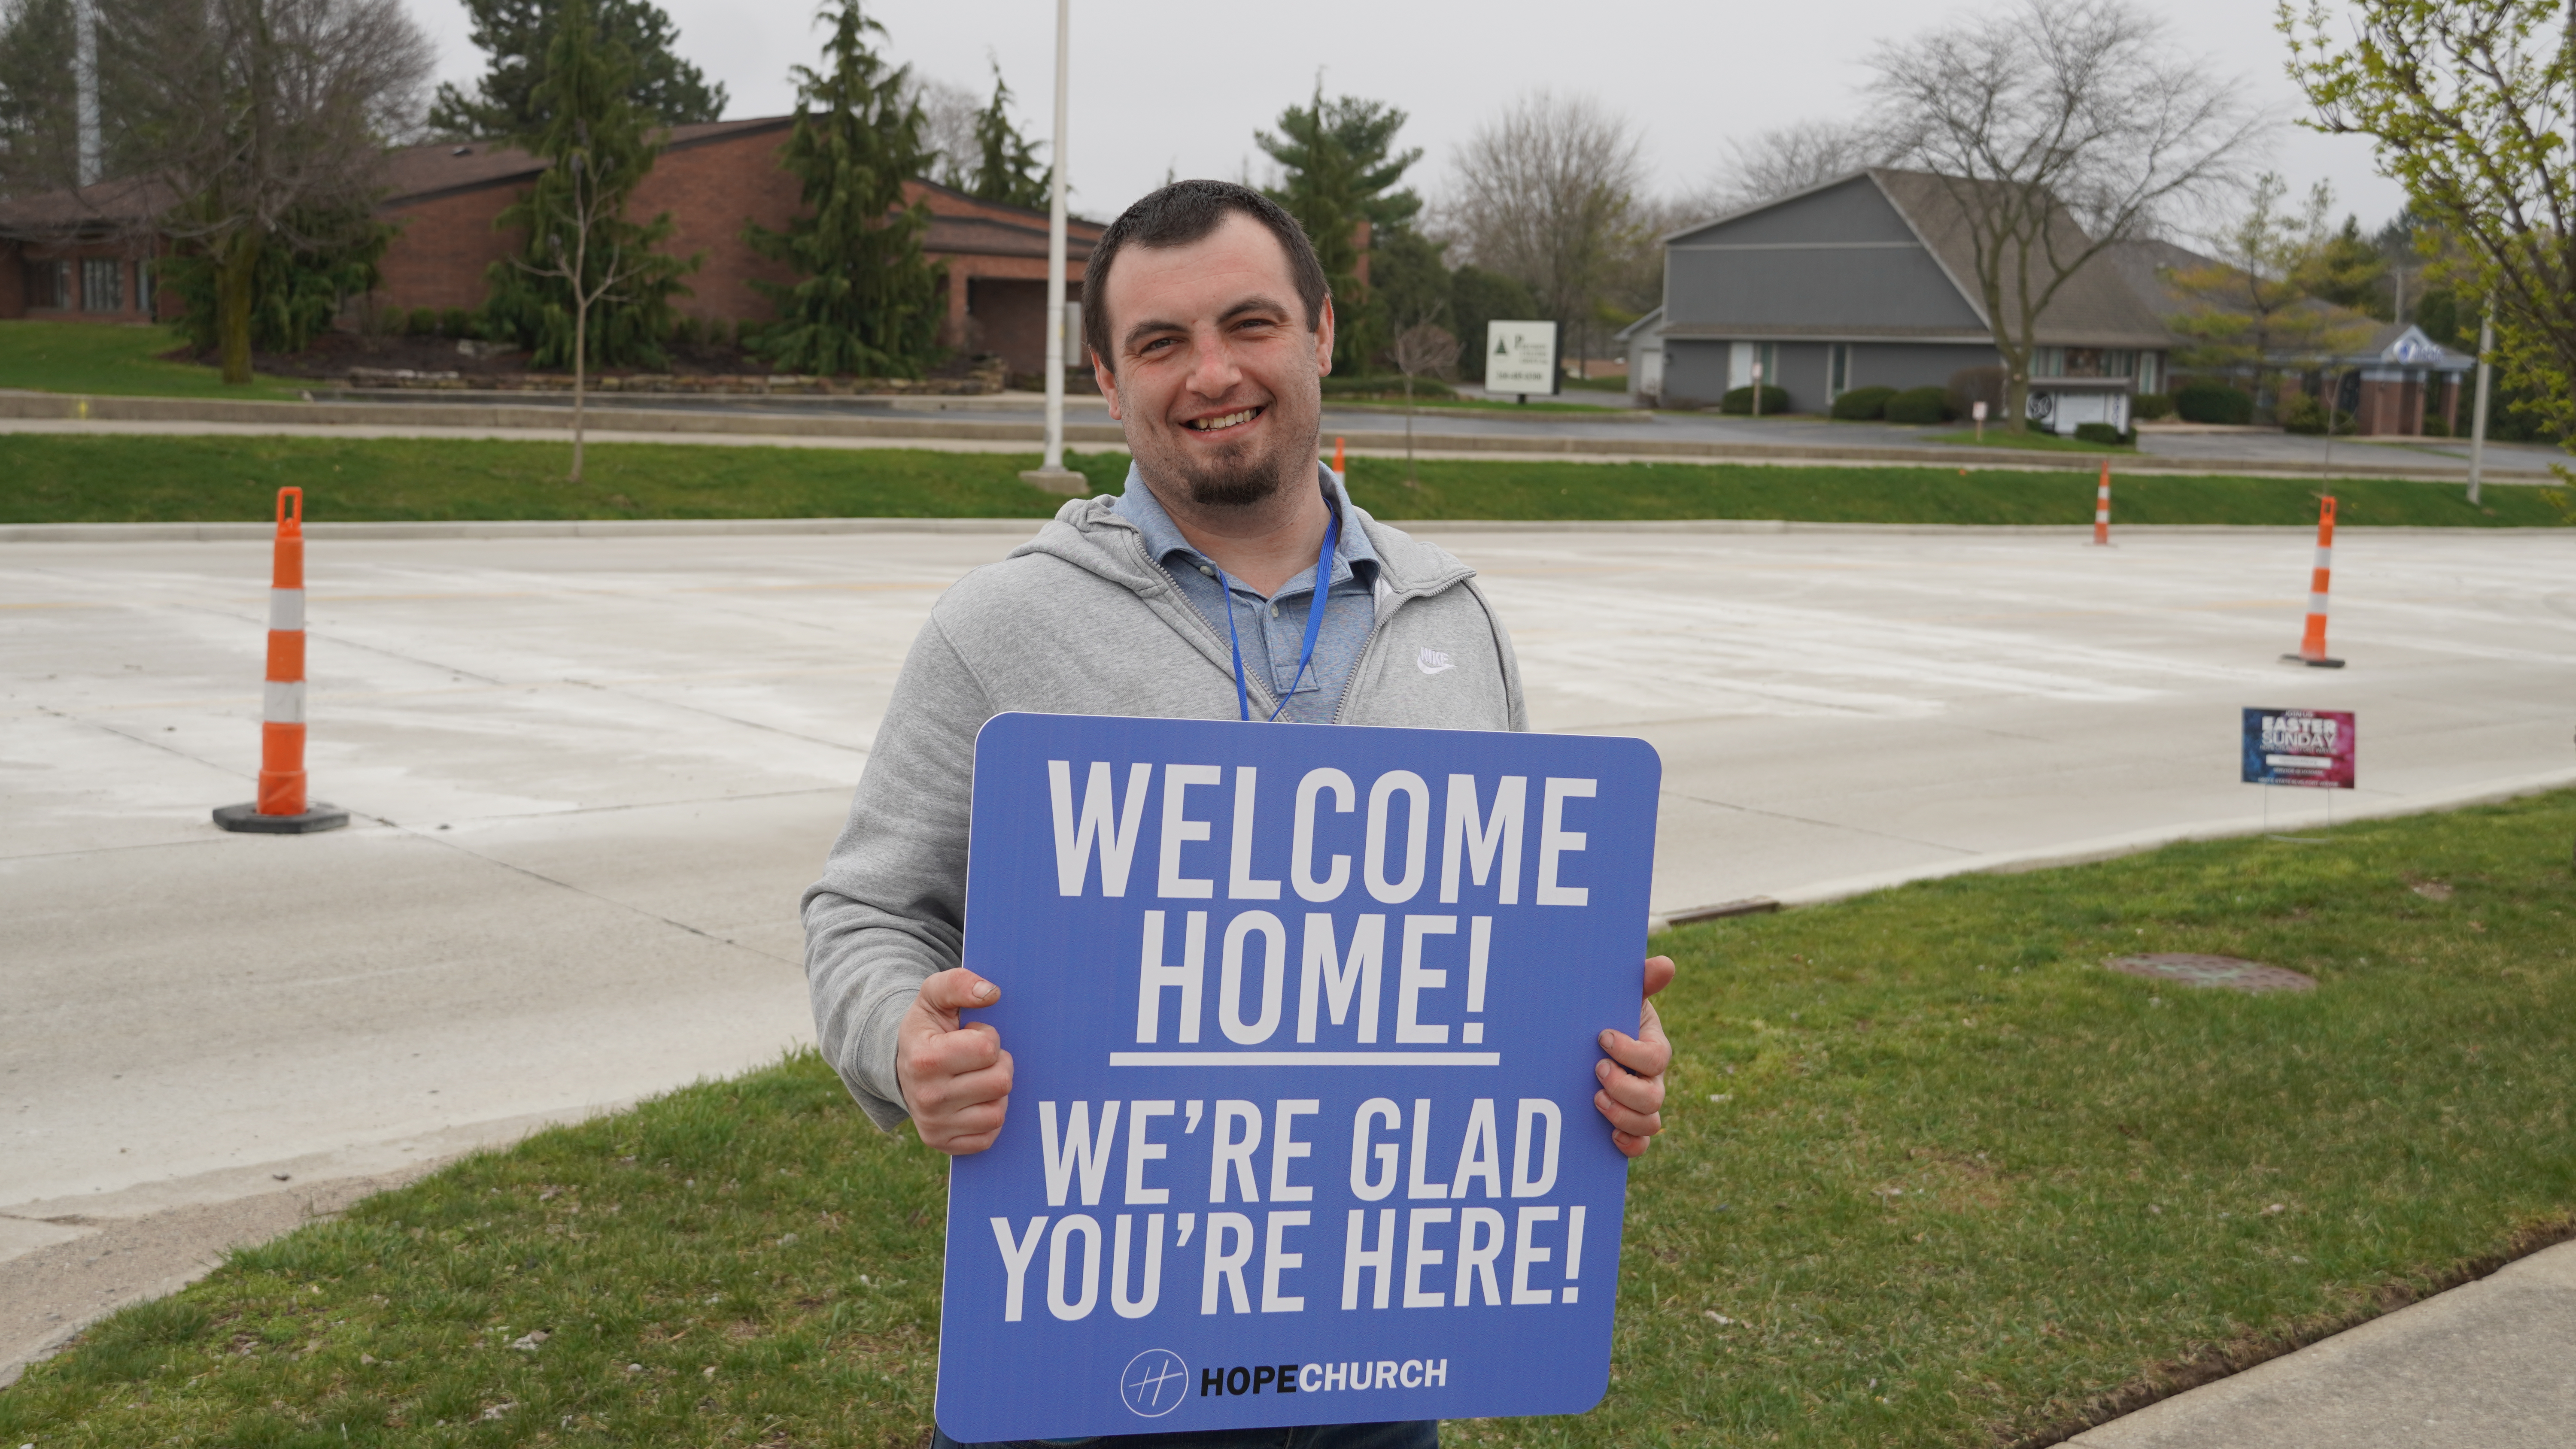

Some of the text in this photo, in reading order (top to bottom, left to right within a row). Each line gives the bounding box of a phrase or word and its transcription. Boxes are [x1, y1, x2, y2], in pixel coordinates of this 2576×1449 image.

[1421, 646, 1449, 666] NIKE
[2262, 716, 2336, 734] EASTER
[2262, 730, 2336, 749] SUNDAY
[1048, 760, 1597, 906] WELCOME
[1136, 910, 1492, 1045] HOME!
[1039, 1098, 1561, 1206] WE'RE GLAD
[990, 1206, 1586, 1322] YOU'RE HERE!
